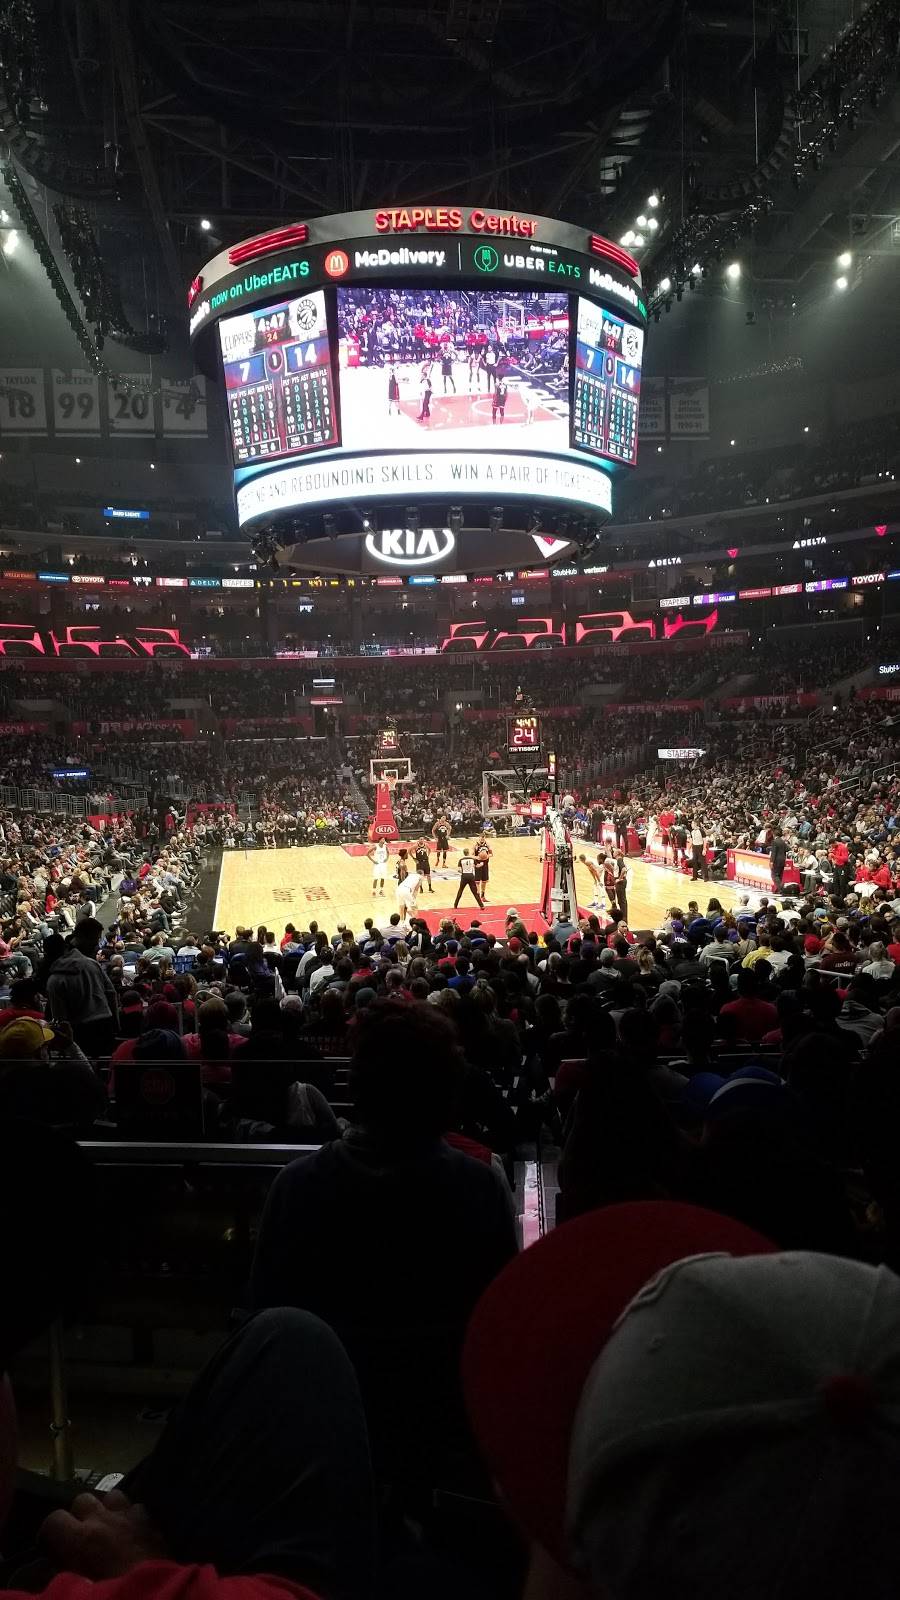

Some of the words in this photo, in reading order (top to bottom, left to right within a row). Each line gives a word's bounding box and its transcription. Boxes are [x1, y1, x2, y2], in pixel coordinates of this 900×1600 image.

[375, 208, 462, 233] STAPLES
[470, 210, 538, 238] Center
[354, 248, 445, 268] McDelivery
[503, 254, 545, 271] UBER
[548, 262, 581, 278] EATS
[211, 290, 228, 309] now
[230, 284, 243, 298] on
[244, 261, 310, 291] UberEATS
[258, 311, 286, 332] 4:47
[266, 331, 278, 343] 24
[294, 343, 317, 367] 14
[239, 362, 250, 382] 7
[59, 392, 94, 419] 99
[114, 392, 149, 420] 20
[291, 466, 374, 495] REBOUNDING
[381, 463, 433, 482] SKILLS
[450, 463, 478, 480] WIN
[486, 463, 493, 480] A
[500, 463, 530, 483] PAIR
[536, 466, 548, 485] OF
[381, 529, 440, 555] KIA
[801, 537, 827, 548] DELTA
[657, 557, 682, 567] DELTA
[553, 568, 578, 577] StubHub
[583, 567, 608, 575] verizon
[852, 573, 885, 585] TOYOTA
[80, 576, 105, 584] TOYOTA
[197, 579, 221, 587] DELTA
[660, 596, 690, 608] STAPLES
[516, 717, 537, 728] 4:47
[382, 736, 394, 745] 24
[513, 728, 535, 744] 24
